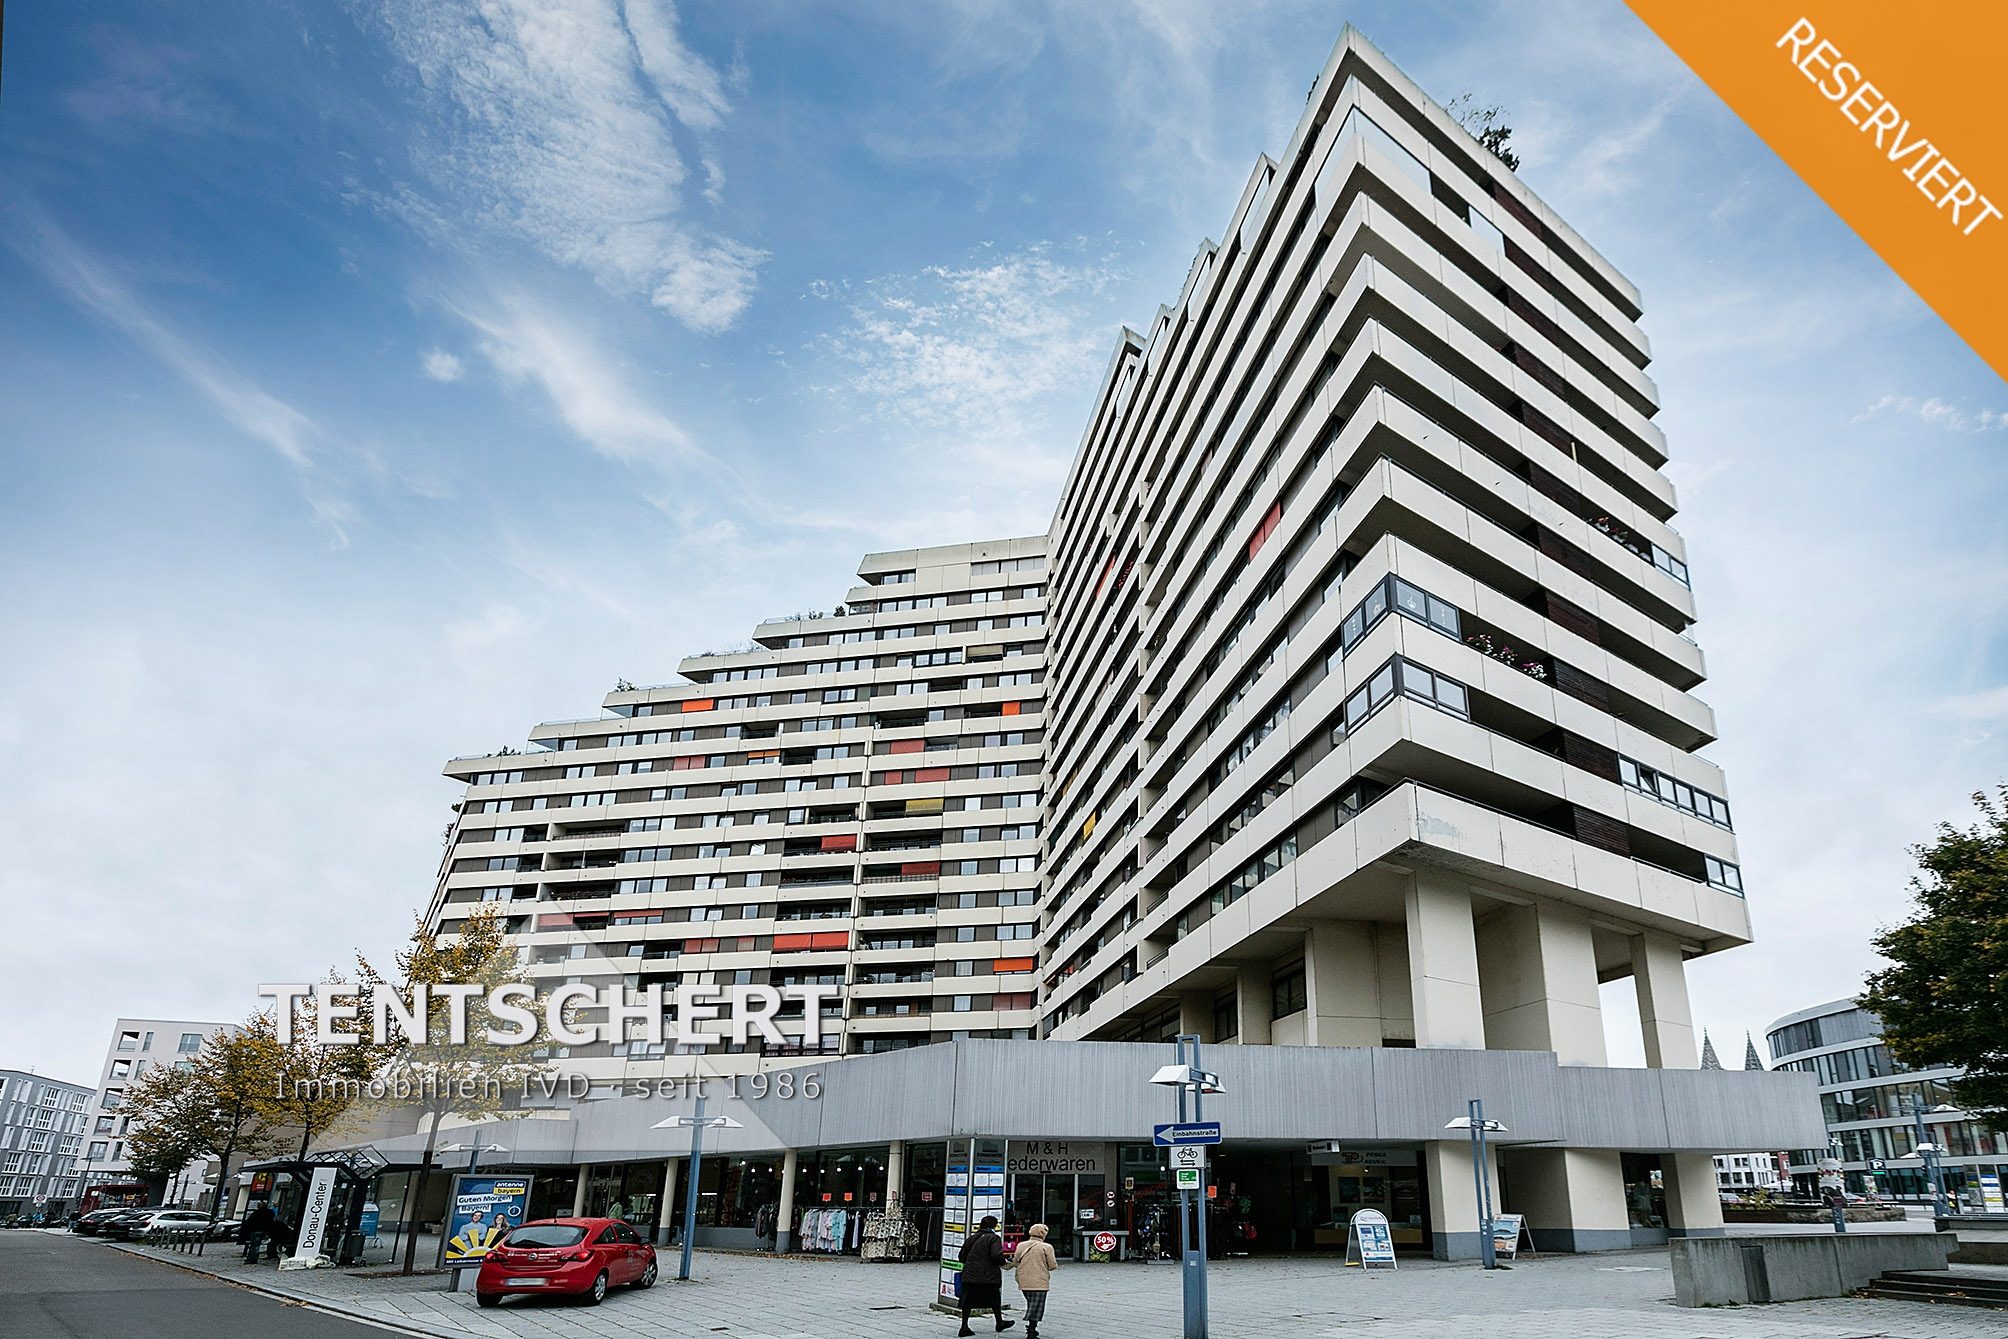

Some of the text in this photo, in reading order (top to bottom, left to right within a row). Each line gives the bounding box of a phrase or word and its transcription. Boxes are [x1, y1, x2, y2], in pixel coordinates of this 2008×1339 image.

[1026, 1141, 1068, 1155] M & H
[1007, 1155, 1096, 1171] ederwaren
[302, 1181, 328, 1249] Donau-Center
